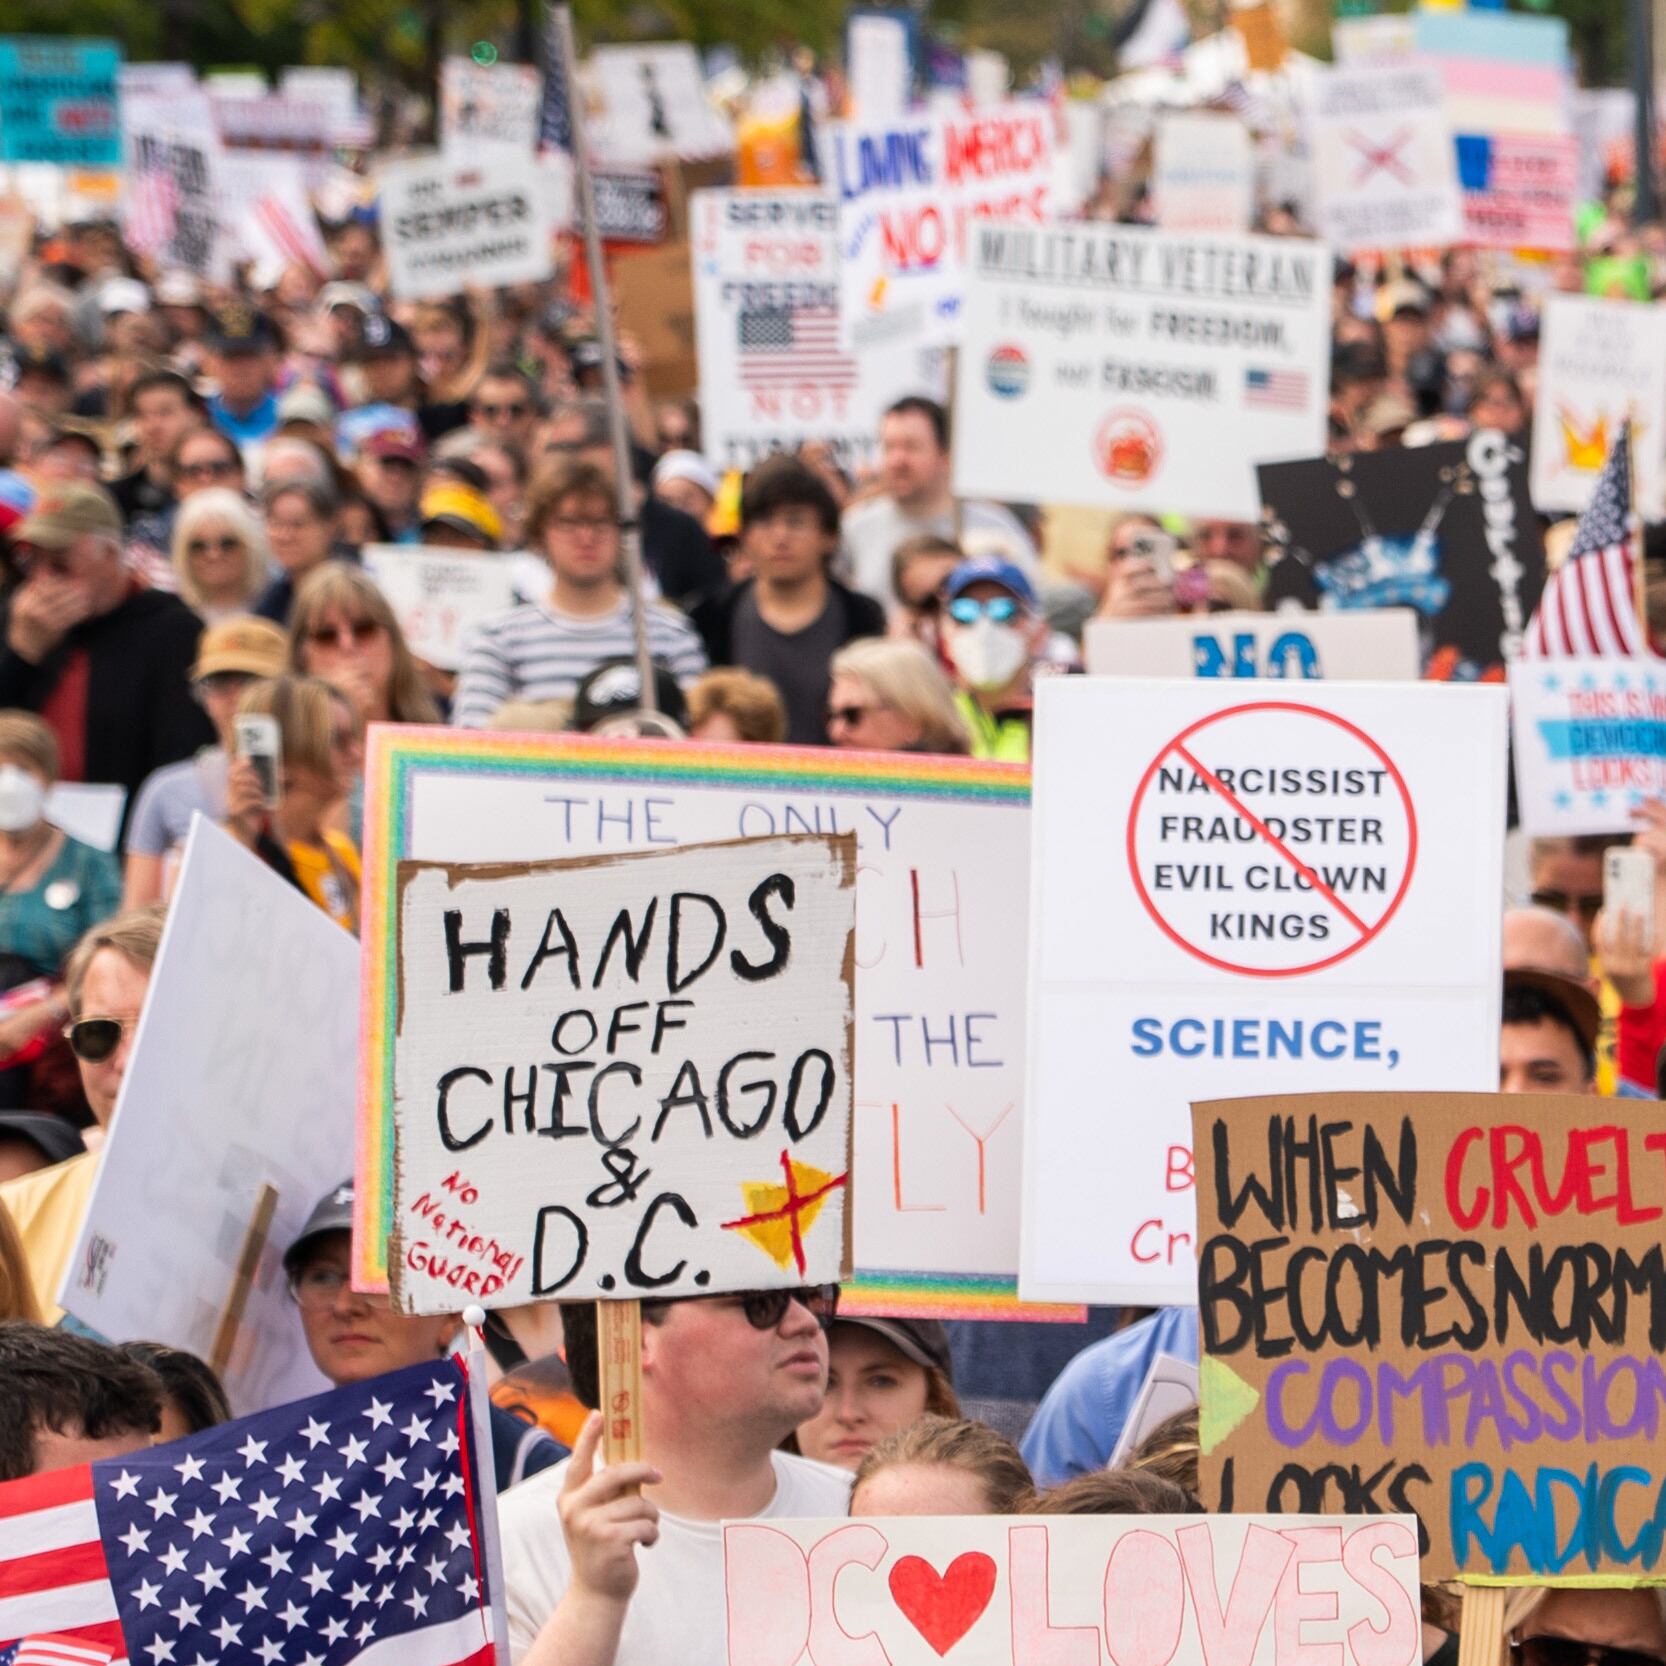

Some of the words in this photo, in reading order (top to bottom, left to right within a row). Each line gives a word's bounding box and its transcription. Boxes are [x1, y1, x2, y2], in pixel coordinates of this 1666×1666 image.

[1156, 240, 1316, 300] VETERAN
[1157, 766, 1390, 797] NARCISSIST
[544, 796, 679, 845] THE
[1158, 814, 1385, 846] FRAUDSTER
[1153, 863, 1235, 893] EVIL
[1244, 864, 1388, 894] CLOWN
[443, 872, 797, 994] HANDS
[1208, 910, 1332, 942] KINGS
[551, 1000, 696, 1056] OFF
[872, 1013, 1004, 1068] THE
[1129, 1016, 1401, 1070] SCIENCE,
[436, 1047, 838, 1152] CHICAGO
[440, 1170, 479, 1206] NO
[586, 1146, 652, 1208] &
[1212, 1112, 1419, 1233] WHEN
[530, 1191, 713, 1298] D.C.
[1201, 1234, 1487, 1358] BECOMES
